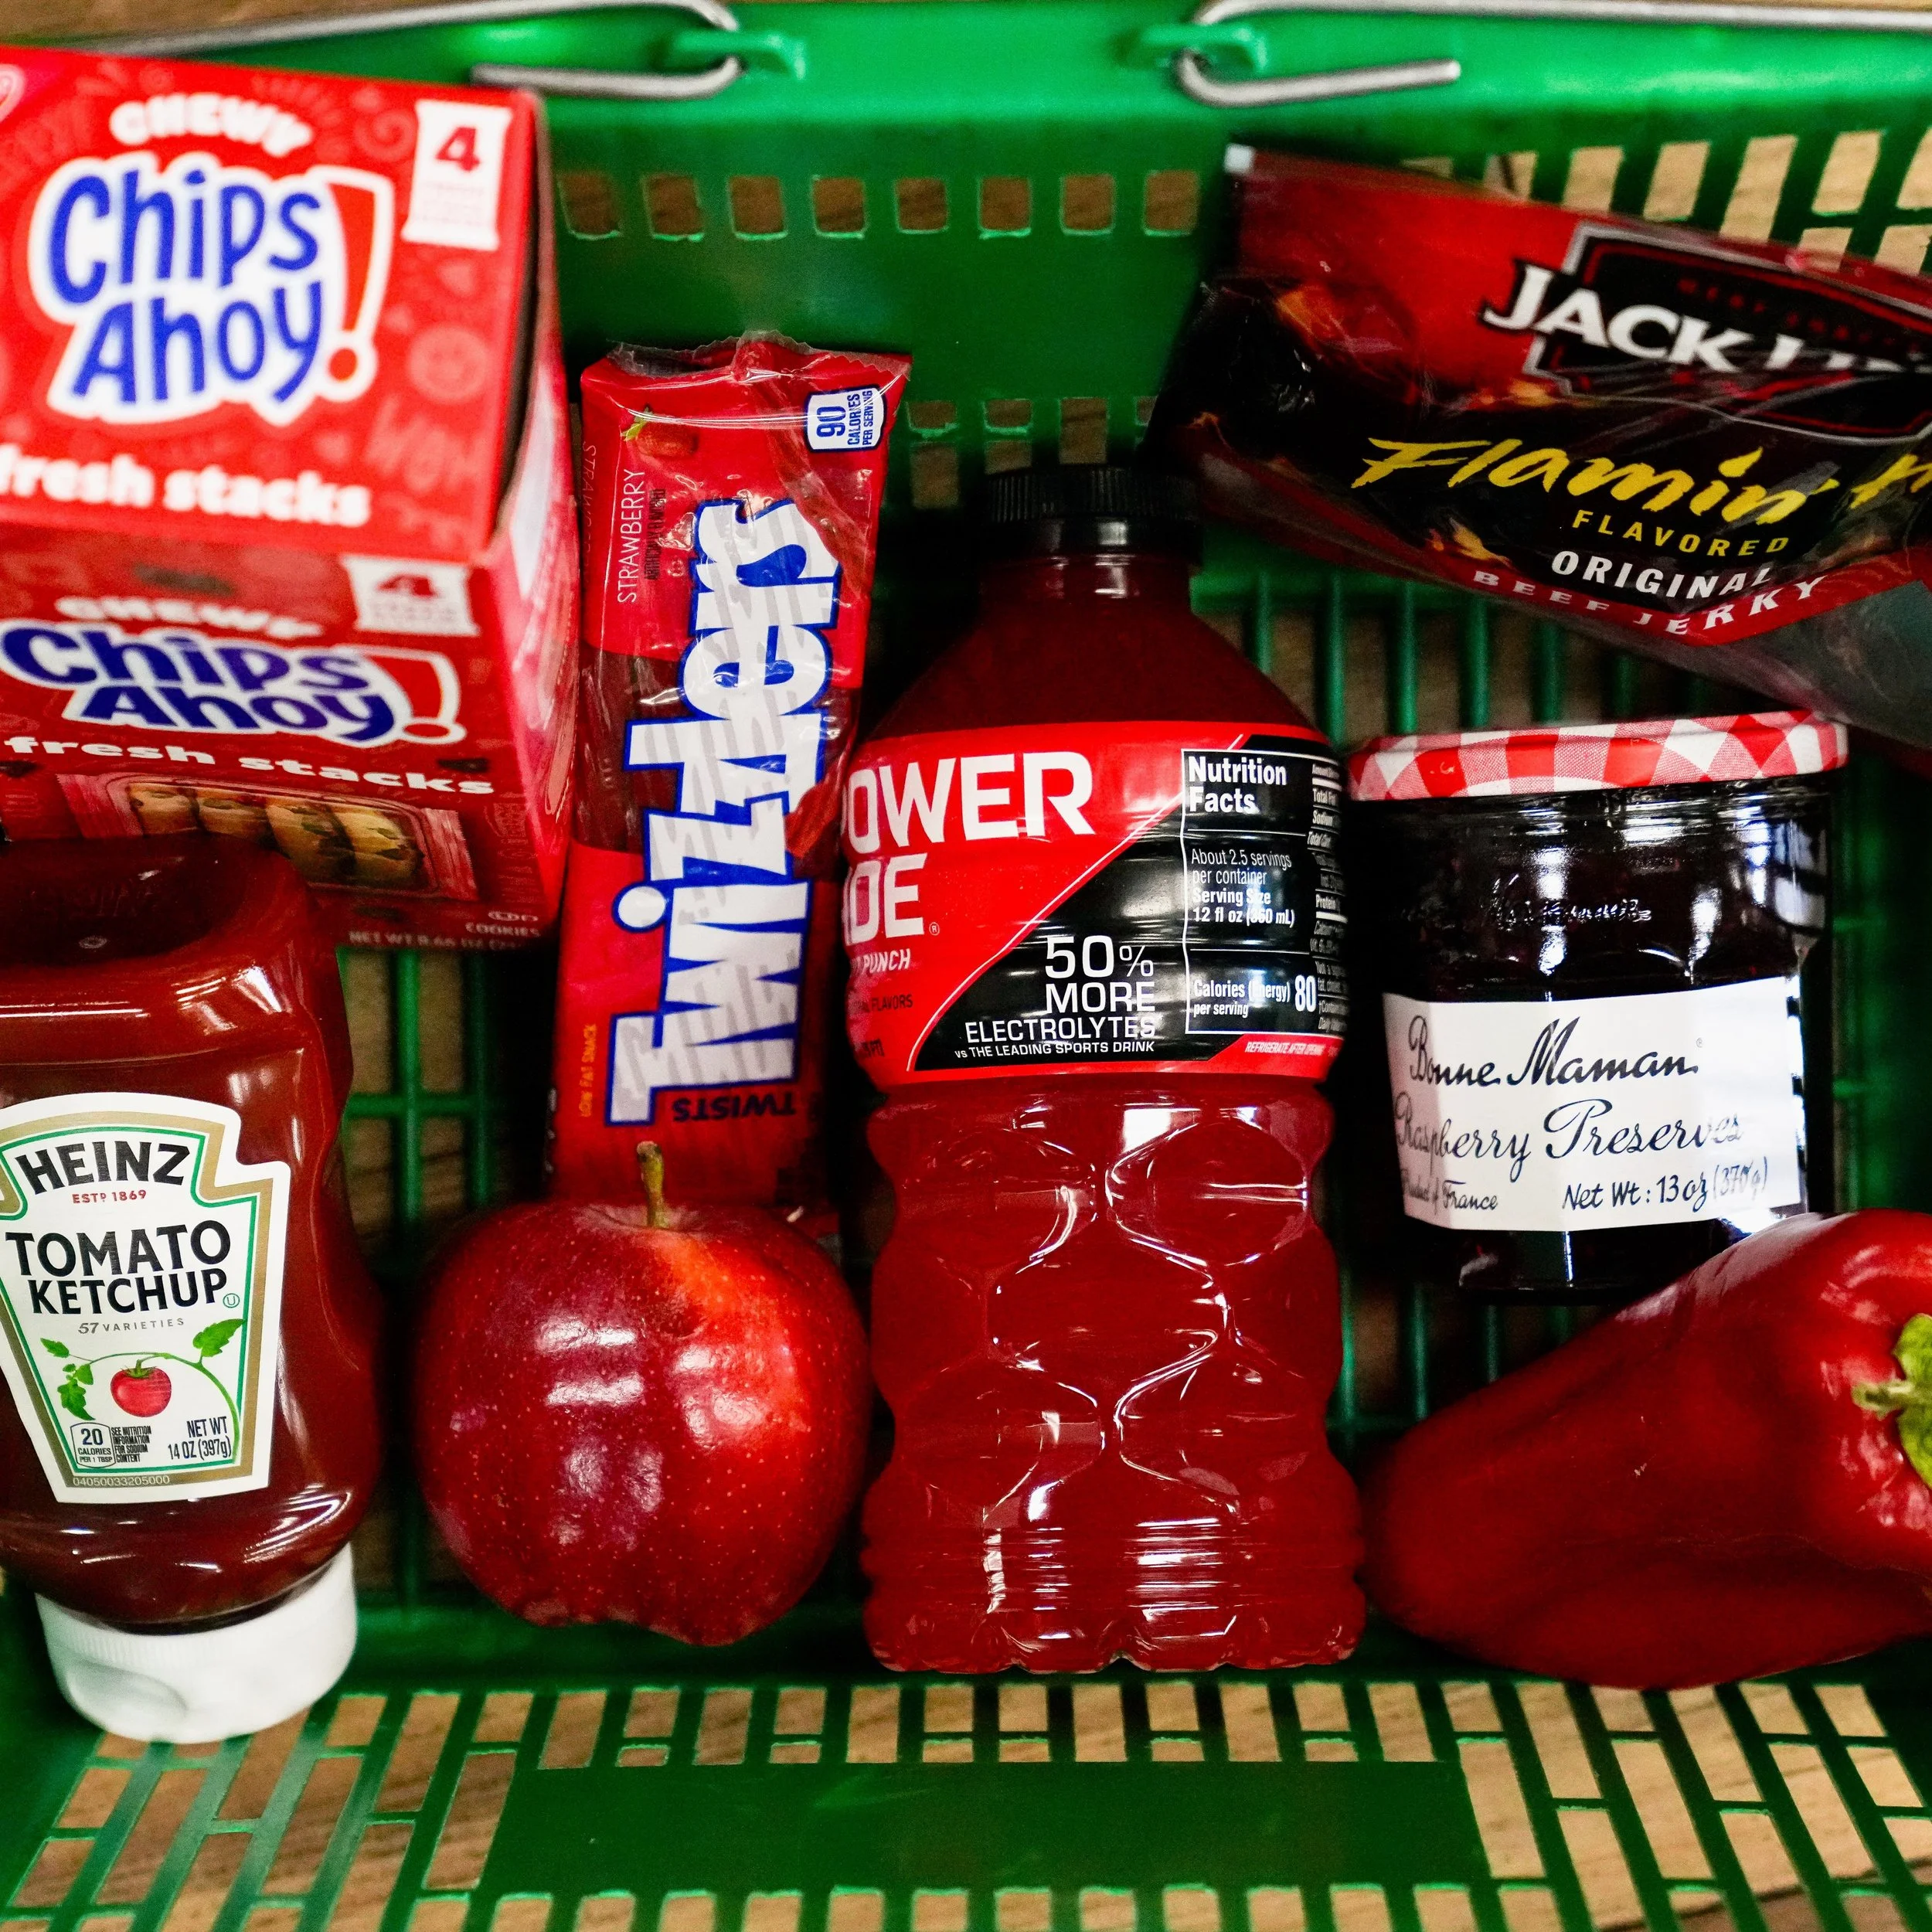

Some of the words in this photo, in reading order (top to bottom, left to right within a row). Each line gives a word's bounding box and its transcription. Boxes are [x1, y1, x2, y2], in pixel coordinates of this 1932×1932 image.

[435, 126, 481, 172] 4
[49, 168, 321, 304] Chips
[1484, 268, 1753, 372] JACK
[816, 406, 846, 437] 90
[847, 393, 862, 446] CALORIES
[862, 429, 873, 446] PER
[163, 465, 371, 528] stacks
[617, 469, 645, 603] STRAWBERRY
[1571, 509, 1789, 558] FLAVORED
[1551, 549, 1772, 600] ORIGINAL
[1473, 570, 1610, 611] BEEF
[1631, 574, 1828, 636] JERKY
[2, 627, 371, 692] Chips
[4, 736, 216, 766] fresh
[238, 753, 495, 795] stacks
[1188, 756, 1287, 786] Nutrition
[609, 500, 839, 1123] Twizzlers
[840, 751, 1096, 854] OWER
[1189, 786, 1259, 814] Facts
[1191, 849, 1227, 866] About
[1230, 849, 1249, 866] 2.5
[1250, 852, 1292, 871] servings
[1192, 869, 1213, 886] per
[1216, 867, 1268, 886] container
[840, 852, 928, 947] DE
[1192, 887, 1244, 906] Serving
[1192, 907, 1211, 923] 12
[1214, 906, 1225, 923] fl
[1228, 910, 1243, 923] oz
[1275, 909, 1296, 929] mL)
[861, 948, 911, 975] PUNCH
[1045, 935, 1154, 979] 50%
[871, 994, 914, 1012] FLAVORS
[1045, 981, 1156, 1015] MORE
[1193, 979, 1245, 998] Calories
[1294, 975, 1317, 1012] 80
[1193, 1002, 1211, 1018] per
[1213, 1001, 1249, 1019] serving
[964, 1015, 1156, 1044] ELECTROLYTES
[954, 1049, 968, 1059] vs
[968, 1046, 993, 1057] THE
[995, 1043, 1053, 1056] LEADING
[1056, 1042, 1109, 1054] SPORTS
[1113, 1041, 1156, 1053] DRINK
[1244, 1041, 1291, 1054] REFRIGERATE
[1408, 1015, 1502, 1087] Bonne
[1506, 1016, 1699, 1086] Maman
[672, 1091, 797, 1122] TWISTS
[1394, 1090, 1532, 1182] Raspberry
[1543, 1098, 1744, 1159] Preserves
[14, 1141, 191, 1196] HEINZ
[112, 1189, 147, 1202] 1869
[1442, 1179, 1498, 1211] France
[1563, 1183, 1604, 1211] Net
[5, 1219, 231, 1277] TOMATO
[27, 1267, 227, 1315] KETCHUP
[77, 1322, 100, 1335] 57
[102, 1318, 185, 1332] VARIETIES
[80, 1427, 104, 1446] 20
[111, 1427, 123, 1436] SEE
[122, 1425, 152, 1435] NUTRITION
[113, 1434, 151, 1445] INFORMATION
[186, 1418, 208, 1438] NET
[210, 1416, 228, 1434] WT
[77, 1447, 112, 1457] CALORIES
[115, 1444, 125, 1454] FOR
[125, 1444, 148, 1454] SODIUM
[116, 1454, 141, 1463] CONTENT
[168, 1443, 180, 1461] 14
[182, 1440, 198, 1459] OZ
[198, 1435, 232, 1461] (397g)
